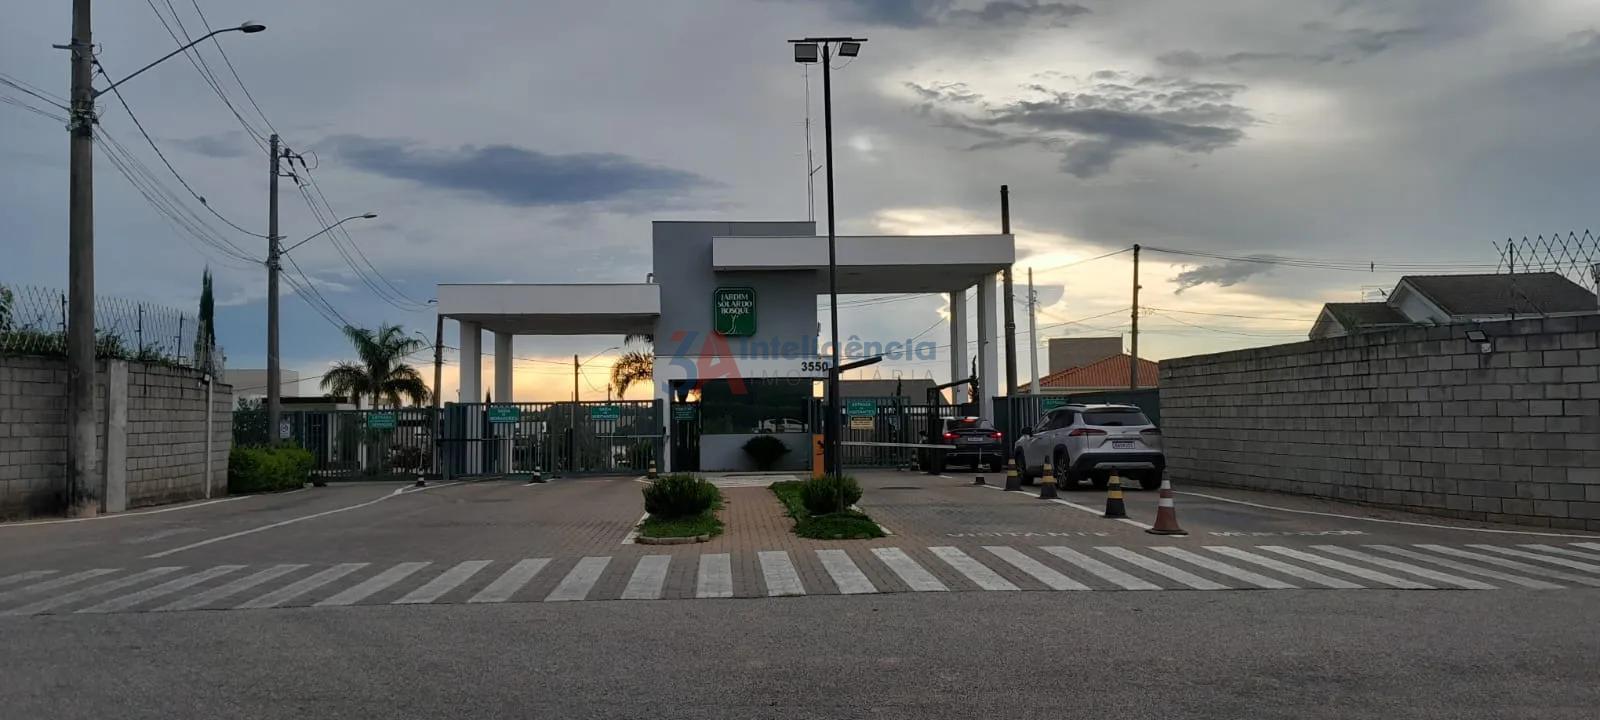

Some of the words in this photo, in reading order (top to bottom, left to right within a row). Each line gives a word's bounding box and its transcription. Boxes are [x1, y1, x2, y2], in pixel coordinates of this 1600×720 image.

[720, 293, 749, 301] JARDIM
[720, 307, 750, 315] BOSQUE
[801, 361, 829, 372] 3550
